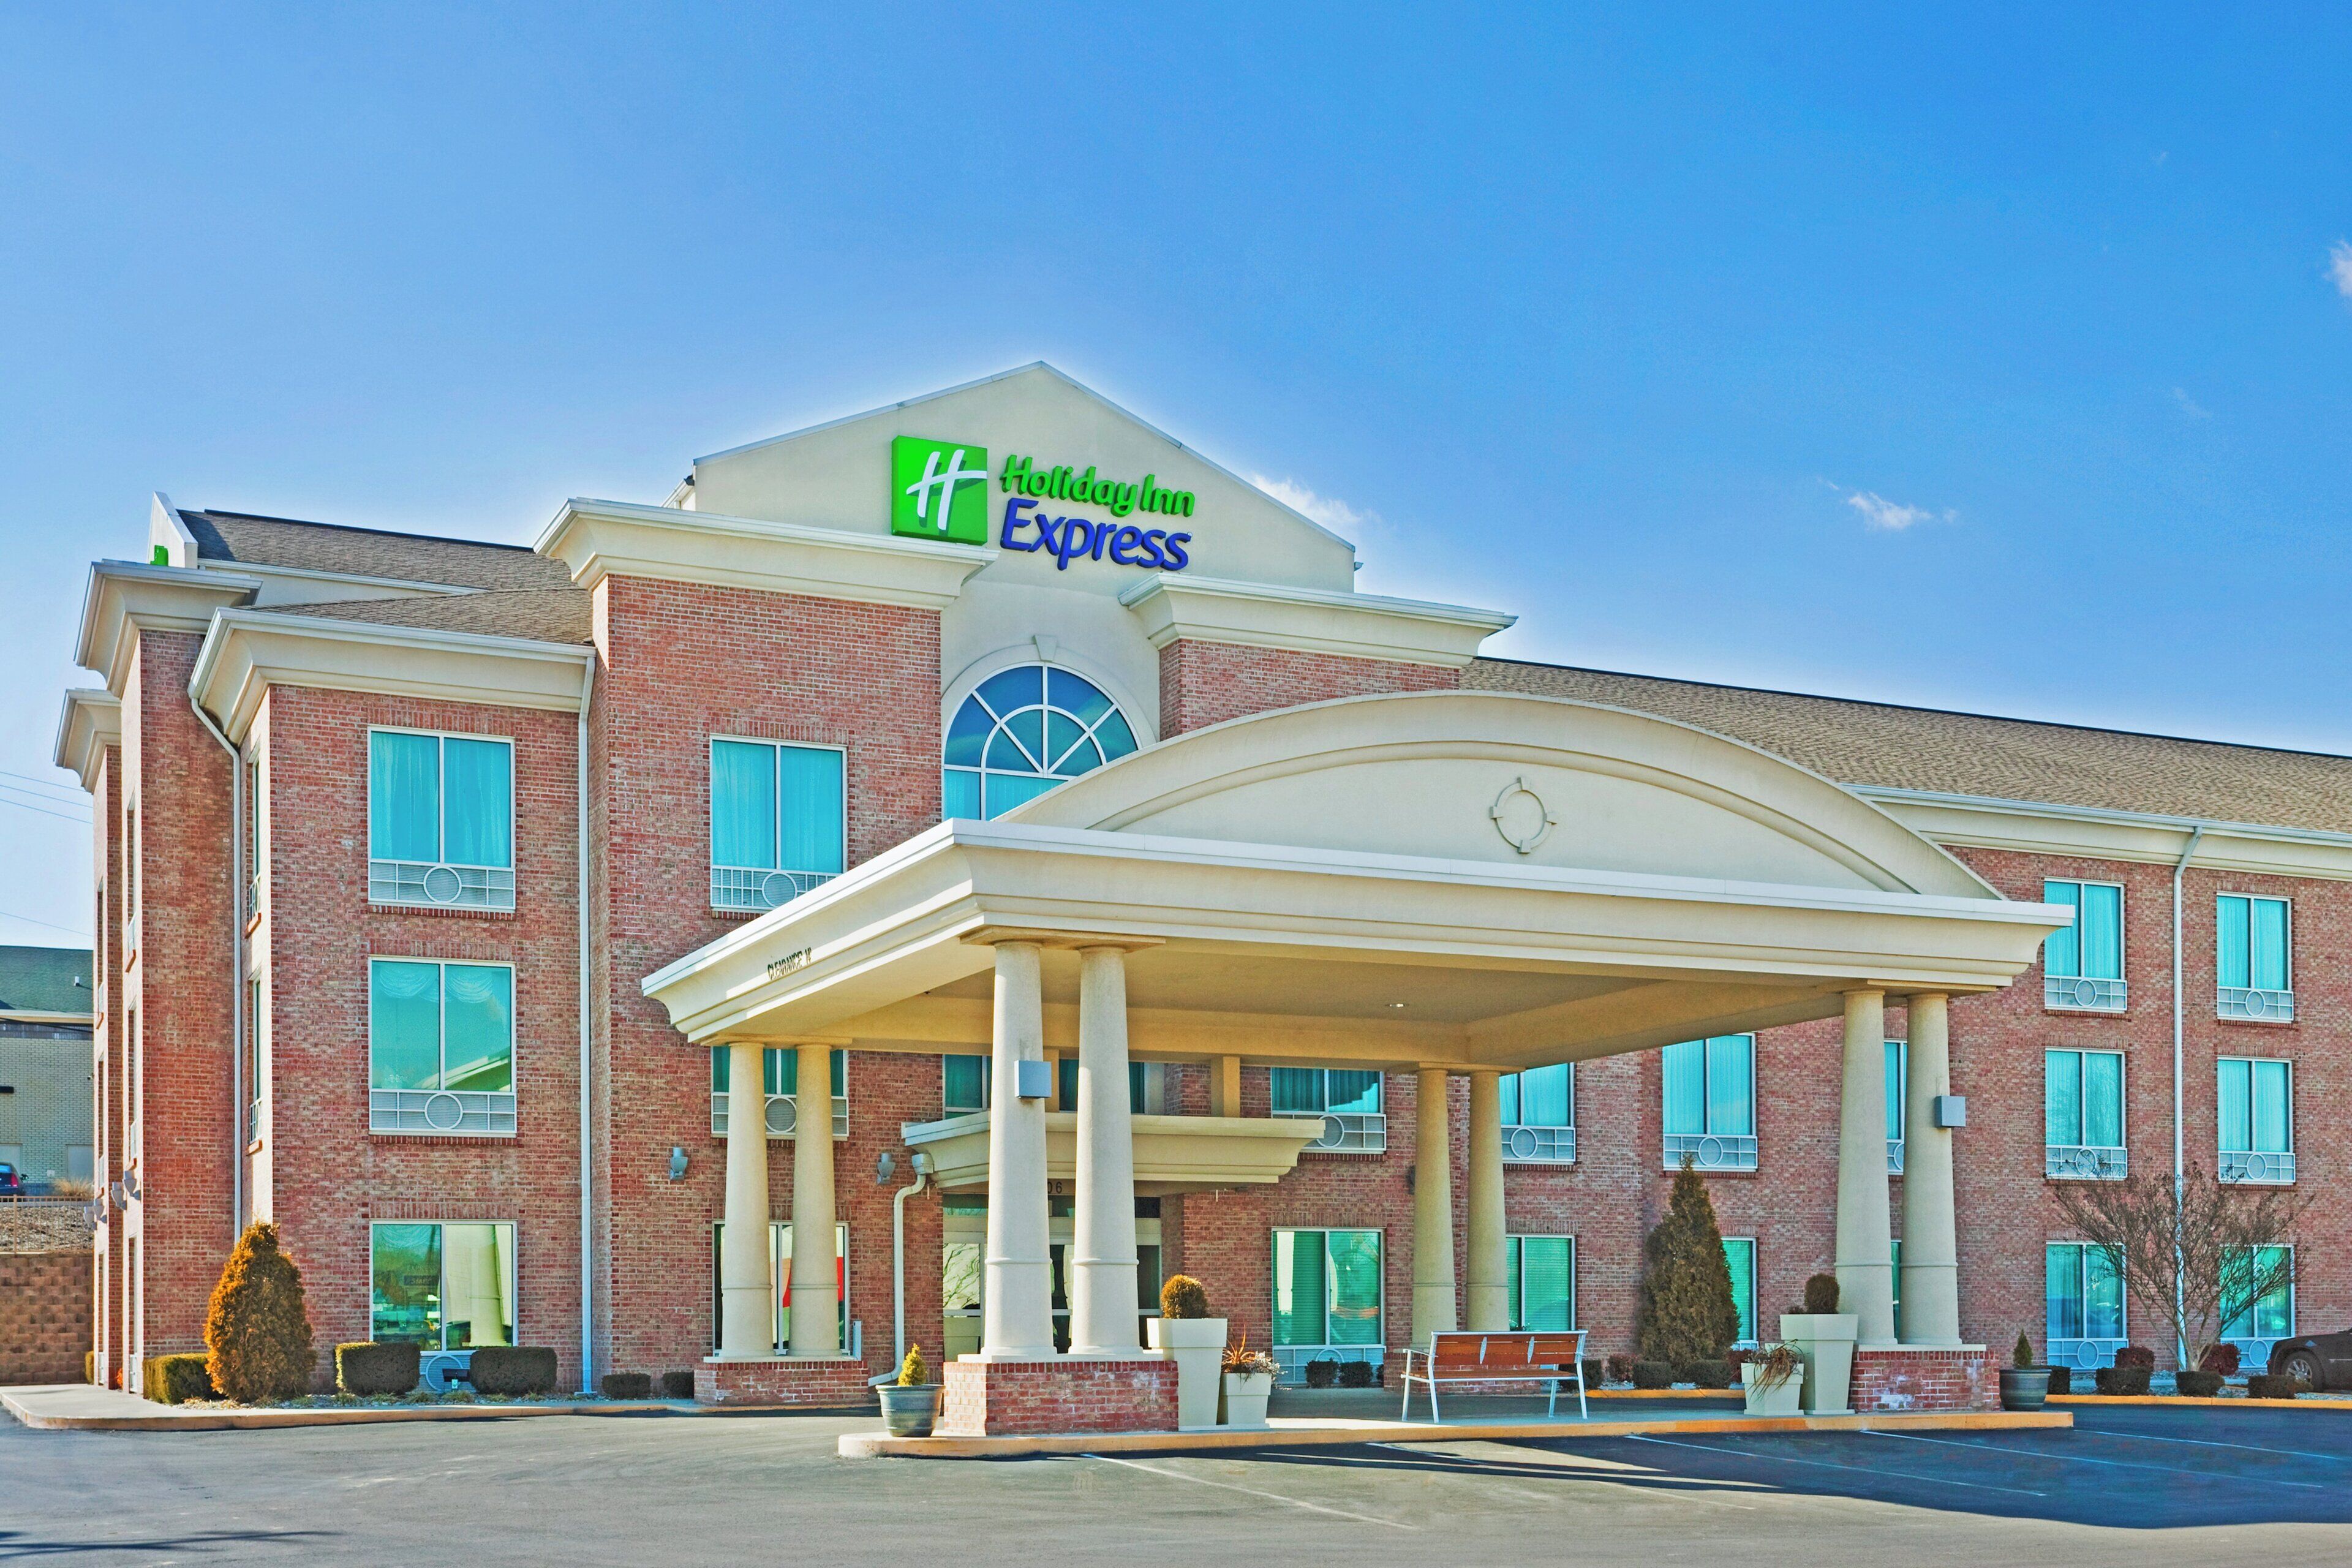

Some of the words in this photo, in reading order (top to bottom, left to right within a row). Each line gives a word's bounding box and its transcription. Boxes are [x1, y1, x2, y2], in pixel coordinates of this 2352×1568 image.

[999, 454, 1138, 517] Holiday
[1140, 474, 1195, 516] Inn
[1000, 497, 1192, 571] Express
